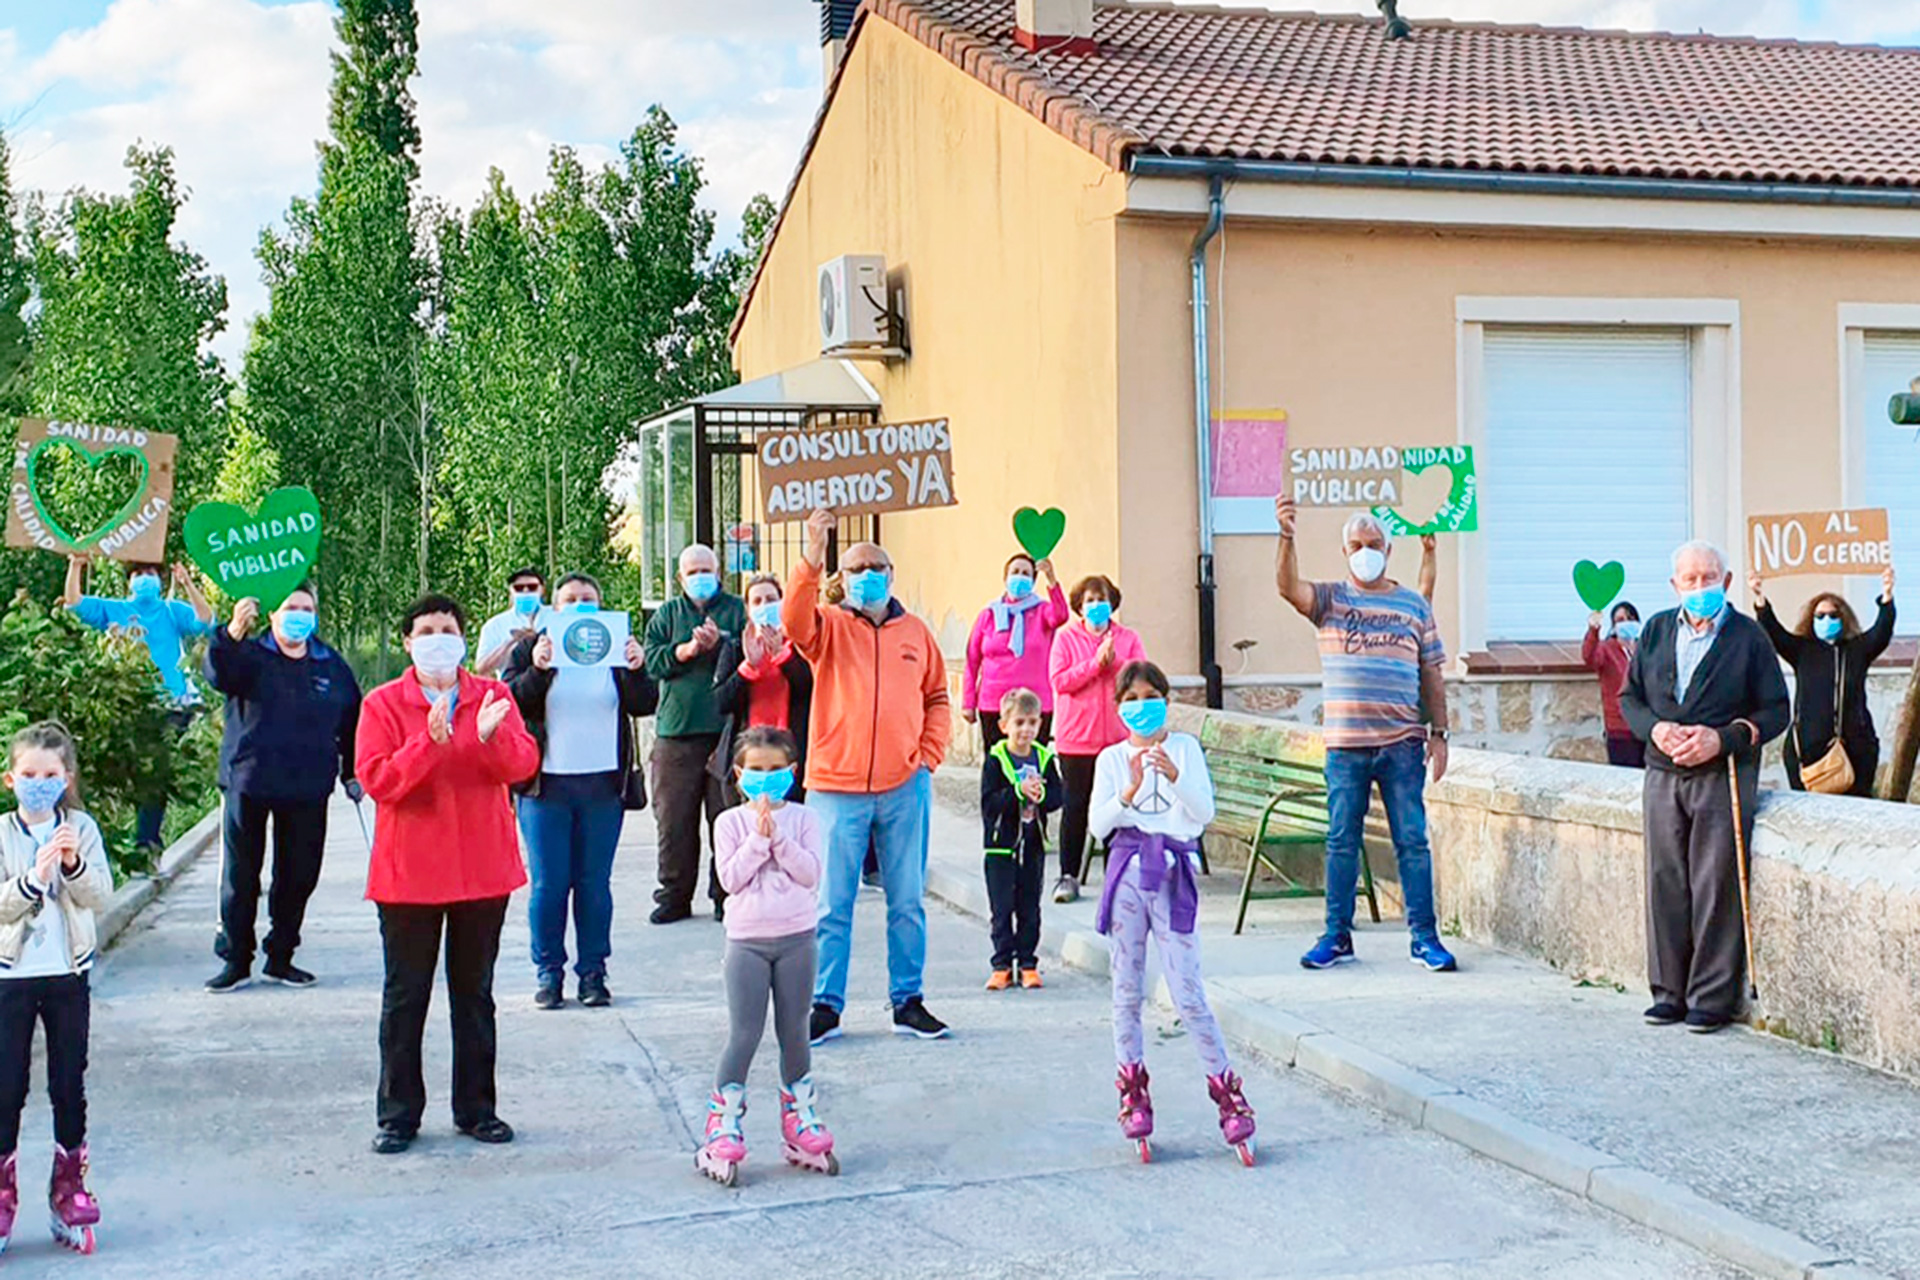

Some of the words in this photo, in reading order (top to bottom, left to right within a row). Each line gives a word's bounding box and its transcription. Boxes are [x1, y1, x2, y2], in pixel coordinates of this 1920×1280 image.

[47, 421, 148, 447] SANIDAD
[762, 420, 951, 466] CONSULTORIOS
[1290, 446, 1398, 473] SANIDAD
[1401, 446, 1466, 465] NIDAD
[768, 469, 893, 513] ABIERTOS
[897, 454, 950, 505] YA
[1293, 474, 1397, 504] PÚBLICA
[1449, 474, 1476, 530] CALIDAD
[12, 482, 55, 550] CALIDAD
[207, 512, 316, 553] SANIDAD
[1753, 520, 1807, 572] NO
[1825, 512, 1859, 533] AL
[1813, 540, 1891, 565] CIERRE
[218, 548, 305, 582] PÚBLICA
